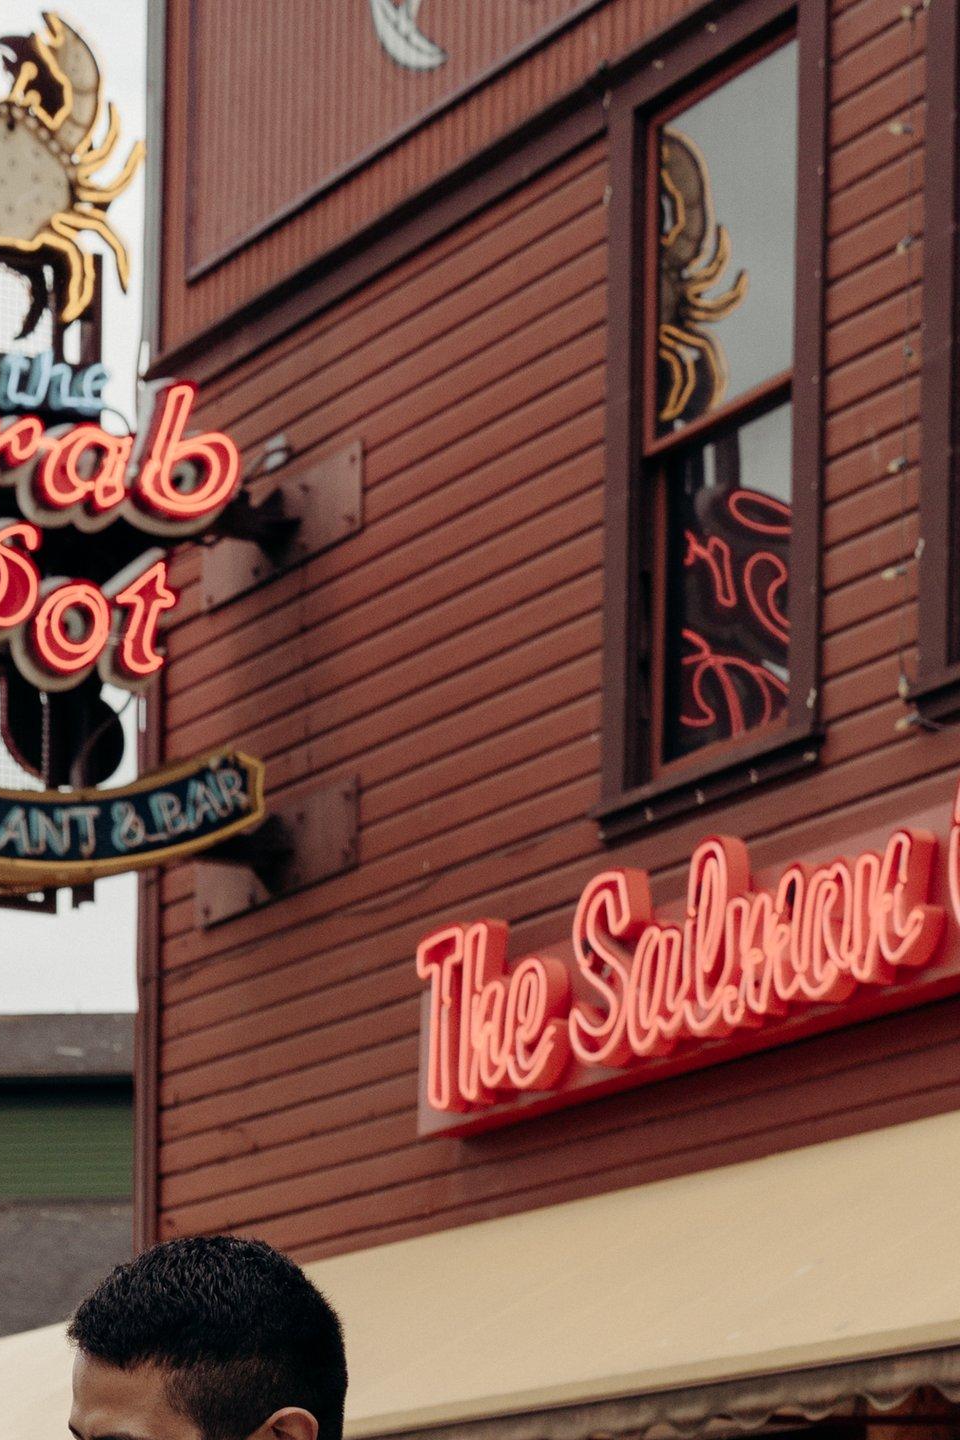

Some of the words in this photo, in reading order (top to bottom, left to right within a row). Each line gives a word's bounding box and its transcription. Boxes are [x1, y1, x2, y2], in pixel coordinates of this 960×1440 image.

[3, 352, 110, 411] the
[110, 801, 146, 851] &
[148, 768, 248, 841] BAR
[416, 921, 558, 1112] The
[567, 830, 932, 1064] Salmon
